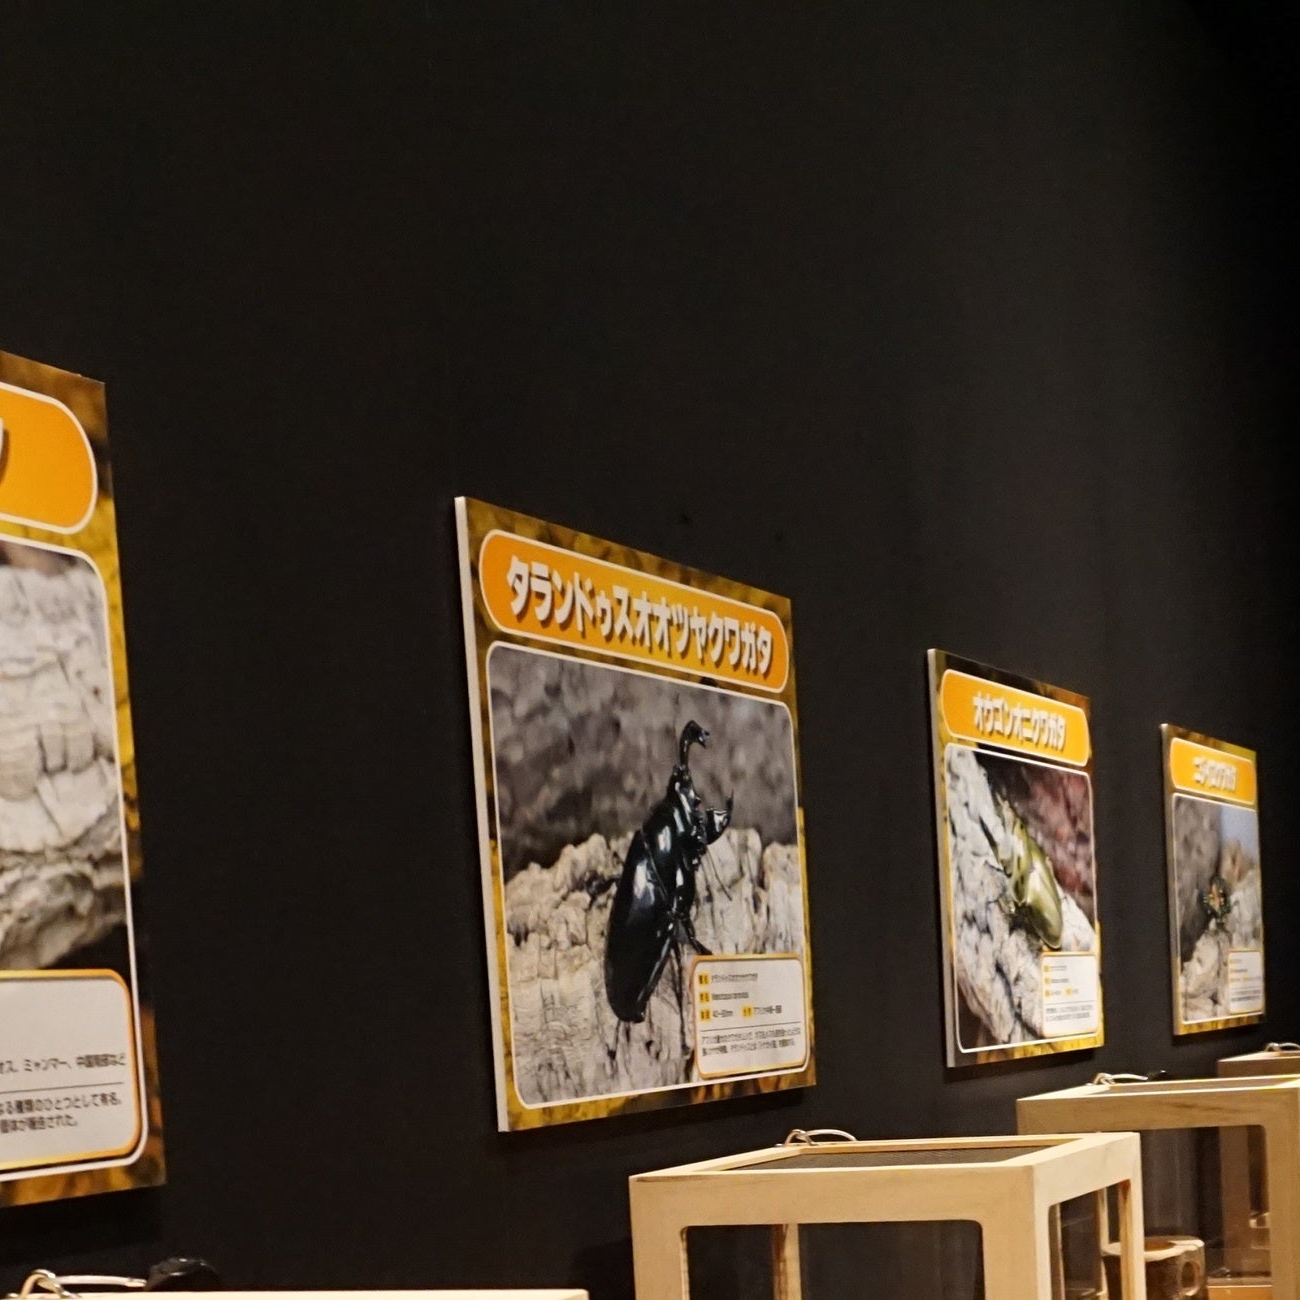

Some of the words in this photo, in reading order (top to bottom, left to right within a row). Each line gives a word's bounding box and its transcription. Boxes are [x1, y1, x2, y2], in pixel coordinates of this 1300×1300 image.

[506, 554, 773, 675] タランドゥスオオツヤクワガタ
